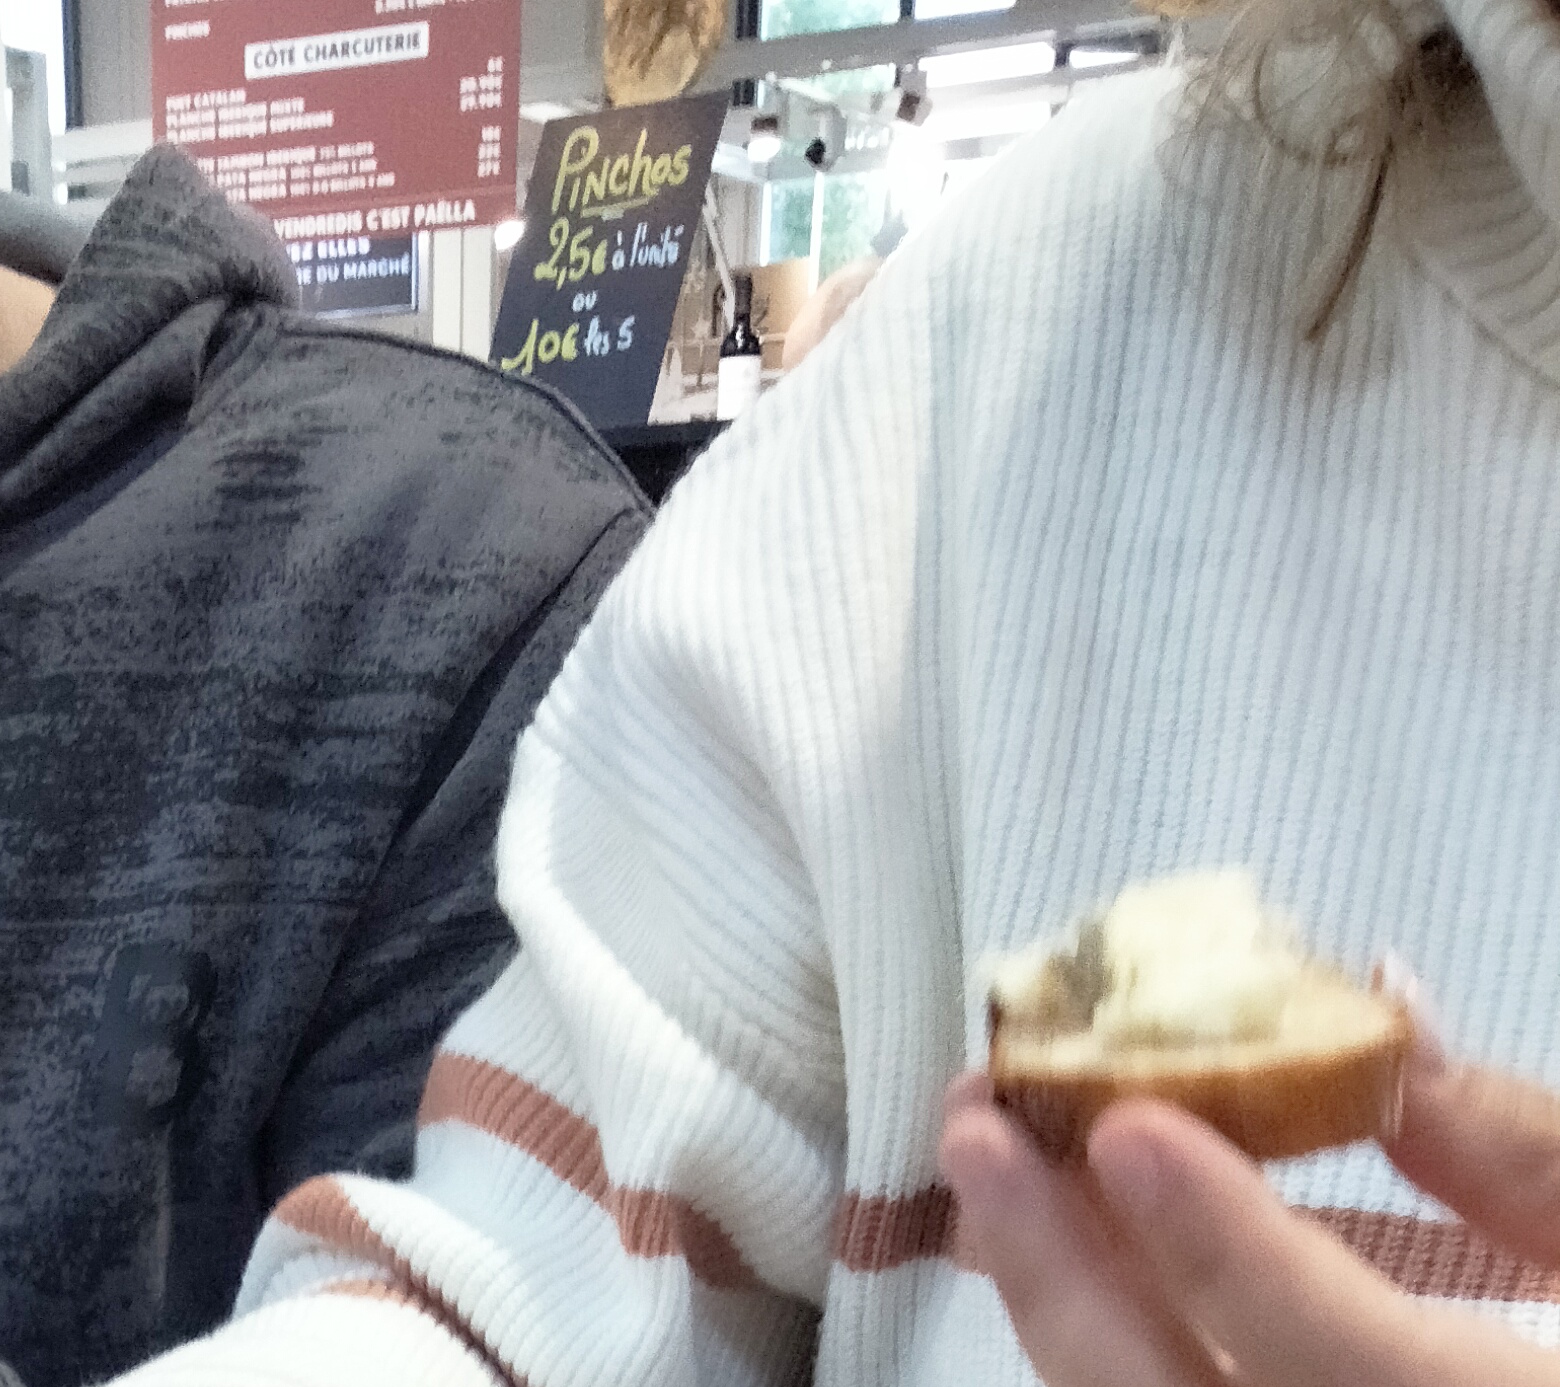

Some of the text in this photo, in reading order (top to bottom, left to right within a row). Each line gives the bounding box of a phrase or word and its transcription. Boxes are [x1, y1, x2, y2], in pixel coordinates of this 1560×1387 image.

[303, 30, 422, 62] CHARCUTERIE
[343, 251, 411, 281] MARCHÉ
[572, 290, 599, 313] ou
